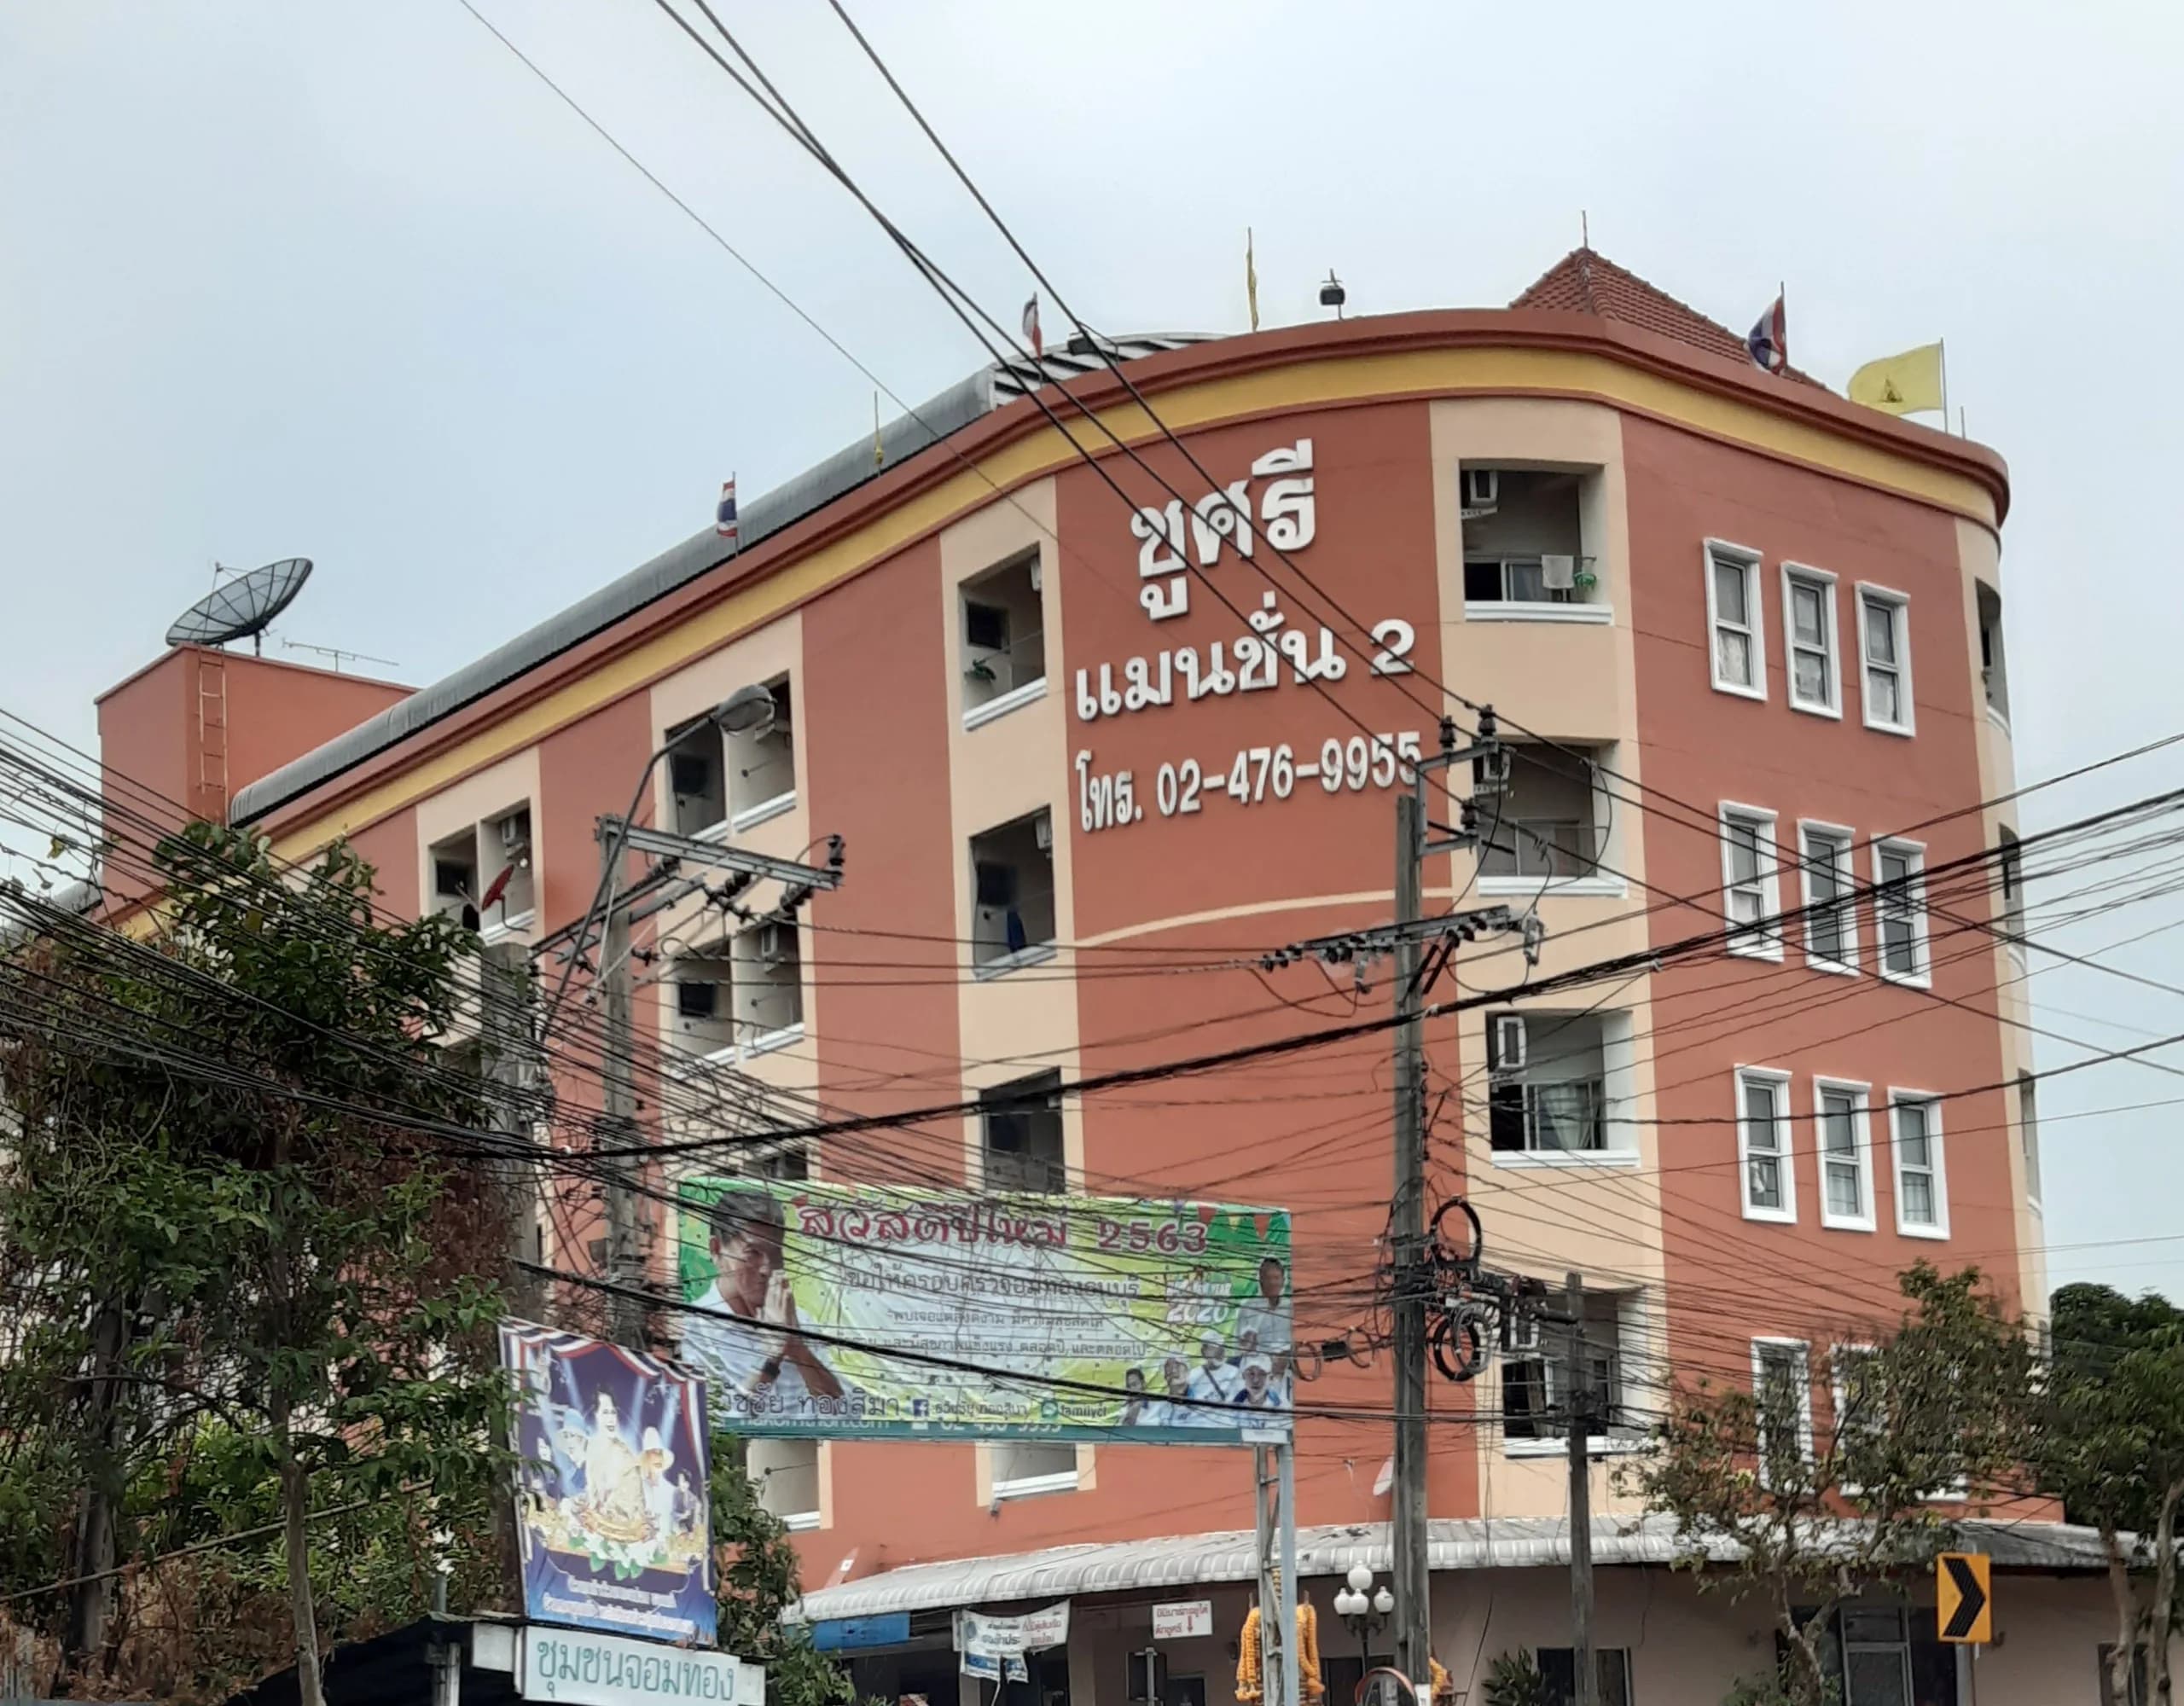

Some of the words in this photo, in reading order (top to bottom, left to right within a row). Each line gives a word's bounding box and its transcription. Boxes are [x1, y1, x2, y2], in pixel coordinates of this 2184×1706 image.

[1130, 438, 1317, 621] ชูศรี
[1075, 589, 1347, 722] แมนชั่น
[1369, 618, 1417, 676] 2
[1076, 749, 1143, 833] โทร.
[1156, 730, 1422, 817] 02-476-9955
[1097, 1219, 1207, 1253] 2563
[1165, 1298, 1230, 1322] 2020
[537, 1639, 735, 1701] ชุมชนจอมทอง
